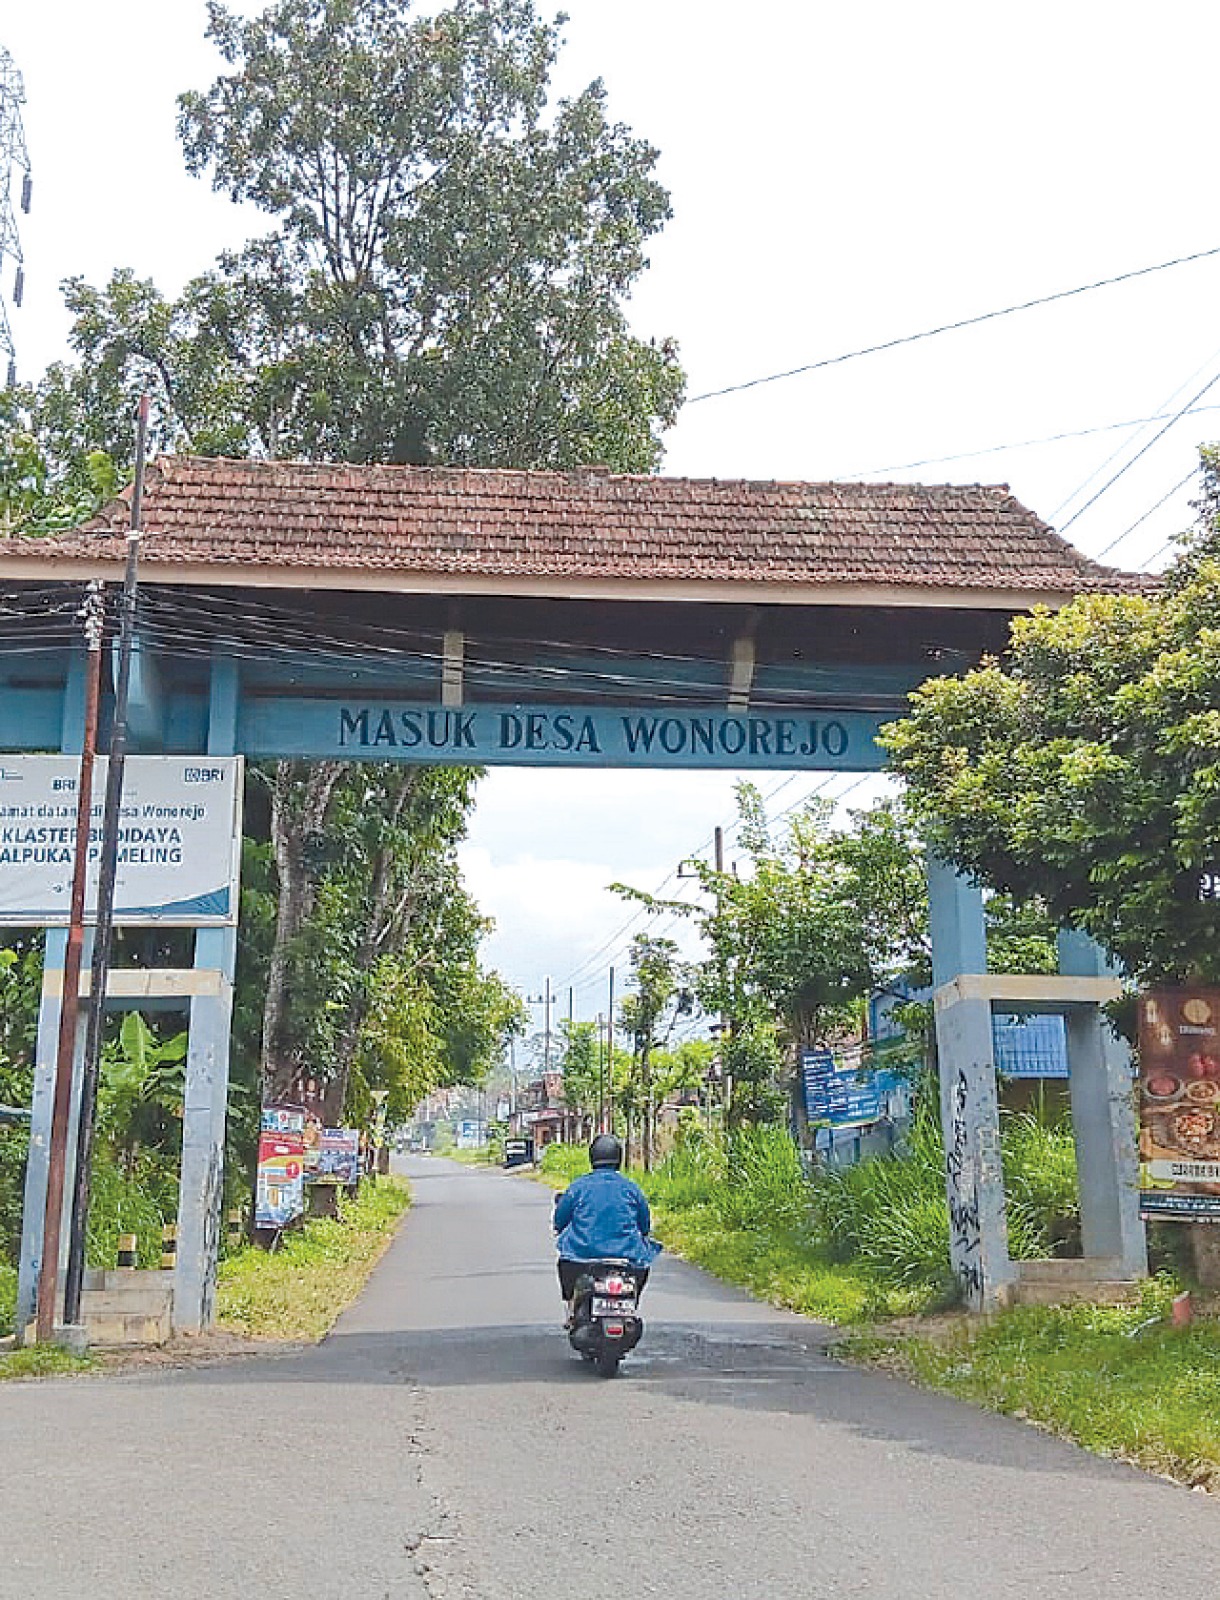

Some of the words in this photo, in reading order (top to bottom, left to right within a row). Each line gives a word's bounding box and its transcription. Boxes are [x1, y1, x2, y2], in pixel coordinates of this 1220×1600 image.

[337, 707, 477, 748] MASUK
[496, 712, 602, 754] DESA
[620, 716, 849, 757] WONOREJO
[201, 768, 224, 782] BRI
[37, 804, 78, 817] datan
[142, 804, 205, 821] Wonorejo
[89, 847, 182, 863] PMELING
